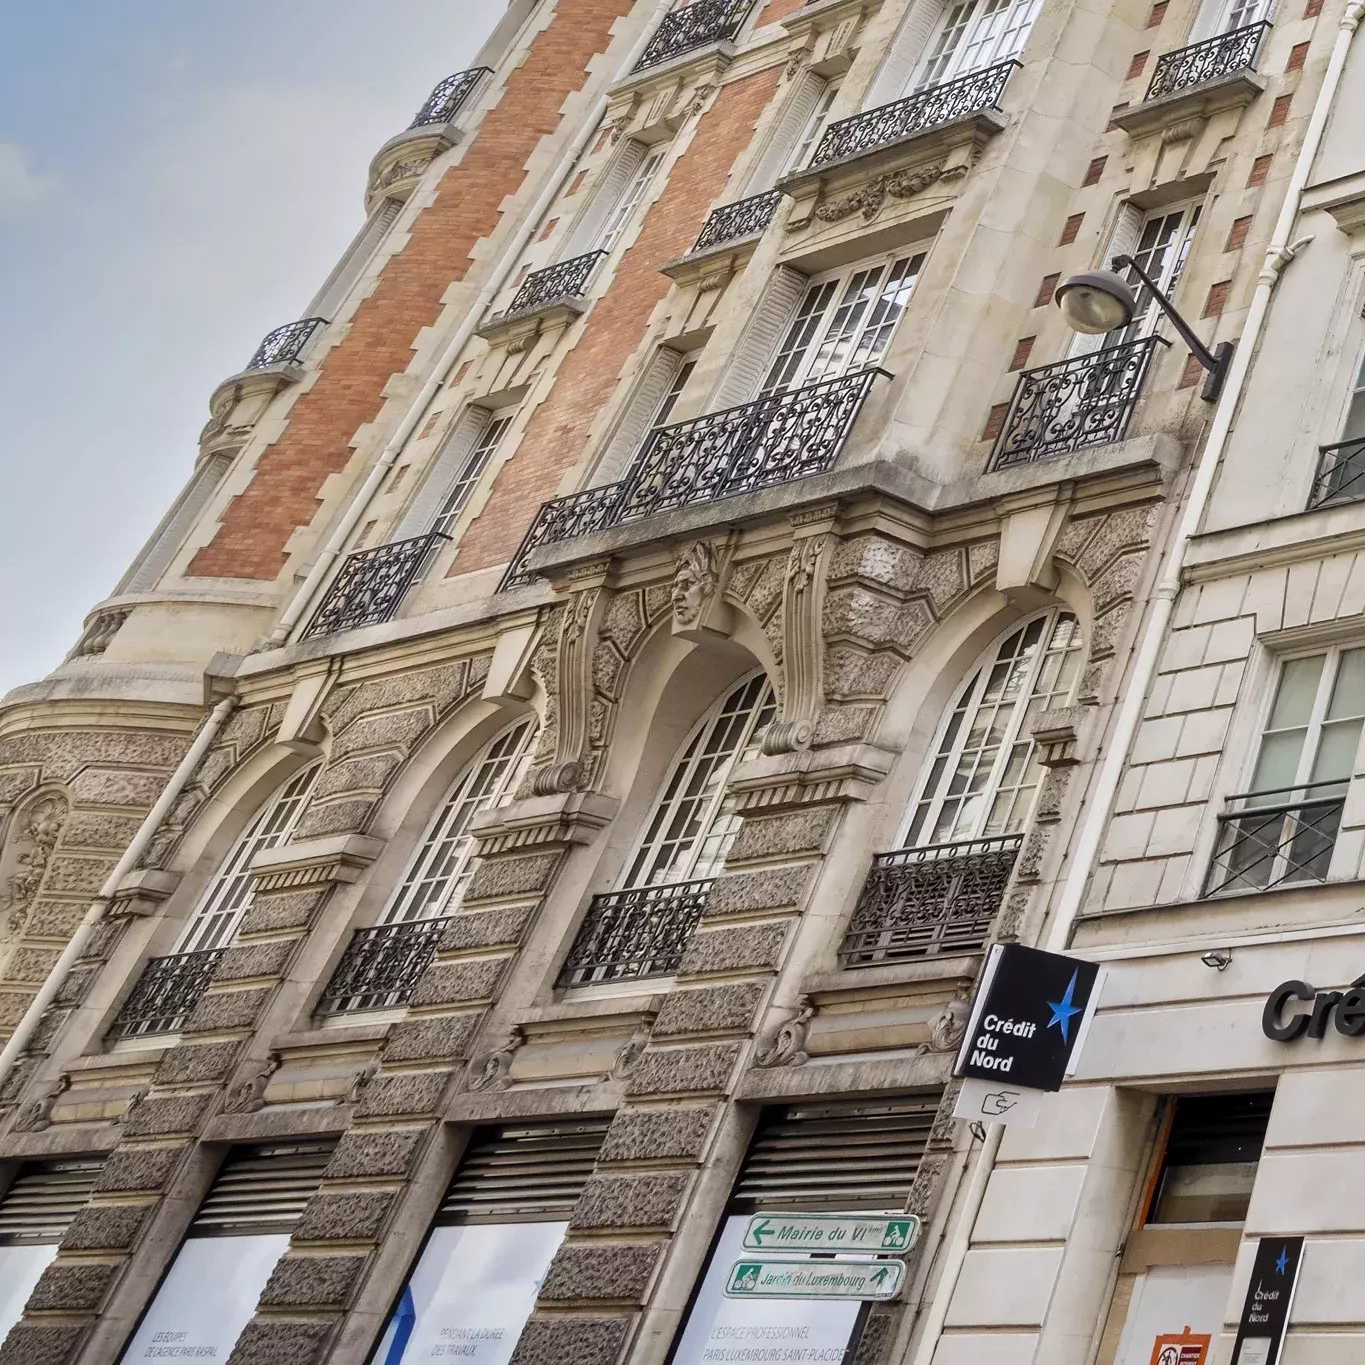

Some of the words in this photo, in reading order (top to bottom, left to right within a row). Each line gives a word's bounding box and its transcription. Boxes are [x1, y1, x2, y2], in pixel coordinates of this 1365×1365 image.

[983, 1014, 1037, 1039] Crédit
[976, 1034, 999, 1051] du
[970, 1049, 1014, 1073] Nord
[777, 1225, 823, 1241] Mairie
[828, 1226, 846, 1241] du
[760, 1272, 792, 1285] Jardin
[793, 1271, 808, 1284] du
[807, 1272, 867, 1291] Luxembourg
[1254, 1290, 1280, 1300] Crédit
[1251, 1302, 1263, 1311] du
[1248, 1313, 1270, 1323] Nord
[711, 1326, 747, 1340] L'ESPACE
[746, 1326, 811, 1339] PROFESSIONNEL
[703, 1348, 726, 1362] PARIS
[725, 1348, 783, 1362] LUXEMBOURG
[782, 1348, 845, 1362] SAINT-PLACIDE
